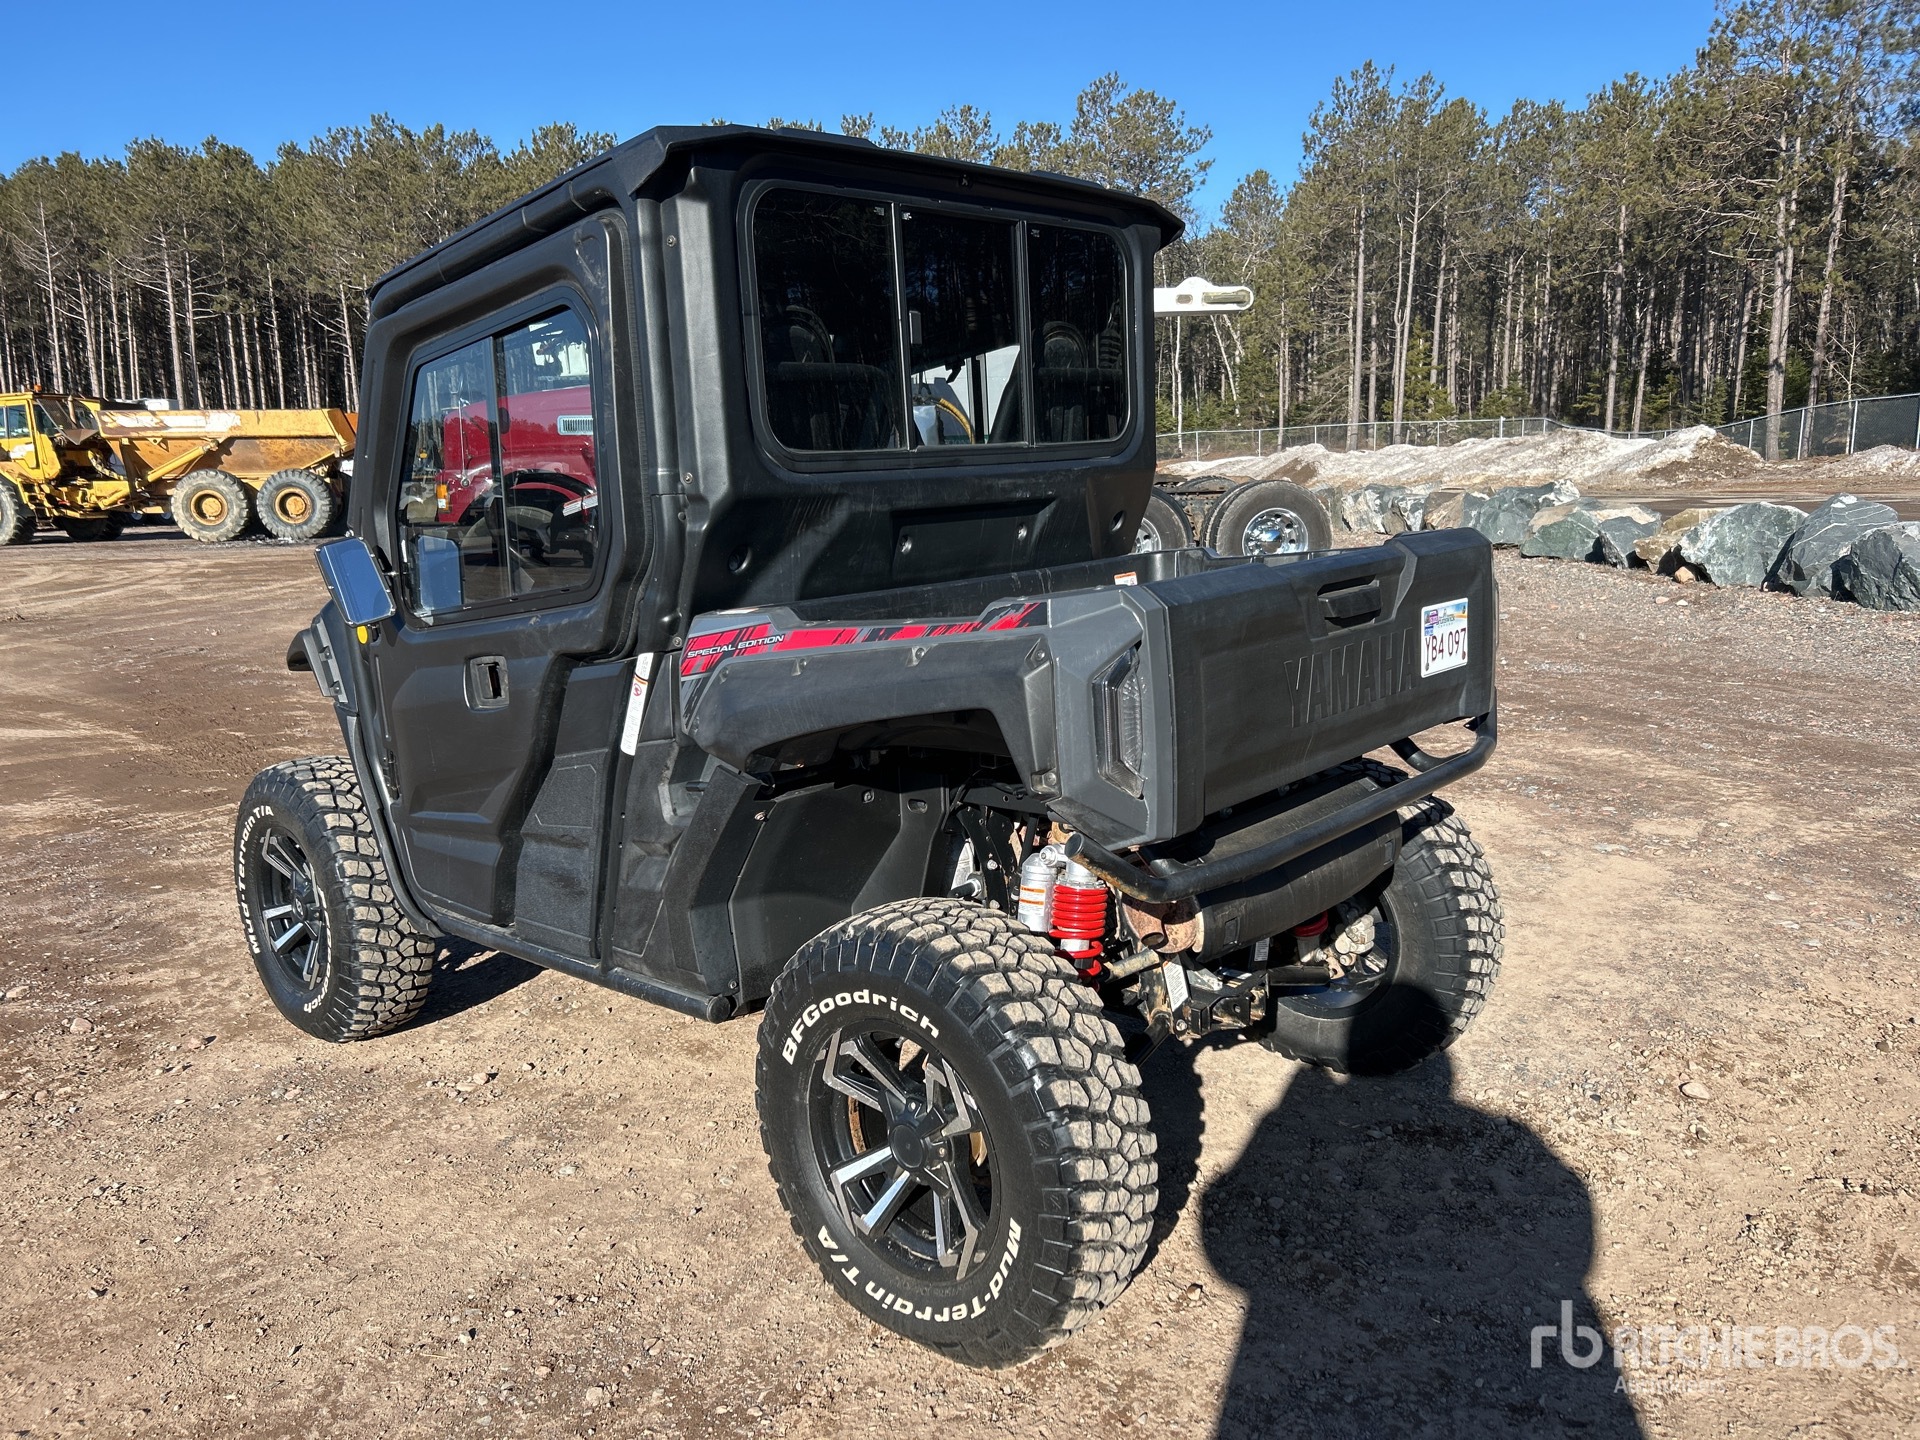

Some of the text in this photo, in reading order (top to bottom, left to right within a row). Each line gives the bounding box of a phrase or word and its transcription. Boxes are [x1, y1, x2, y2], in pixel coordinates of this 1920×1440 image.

[687, 634, 785, 658] SPECIAL EDITION
[1284, 627, 1416, 728] YAMAHA
[1425, 627, 1467, 665] YB4 097
[238, 815, 261, 954] Mud-Terrain
[782, 989, 940, 1065] BFGoodrich
[818, 1217, 1022, 1322] Mud-Terrain T/A
